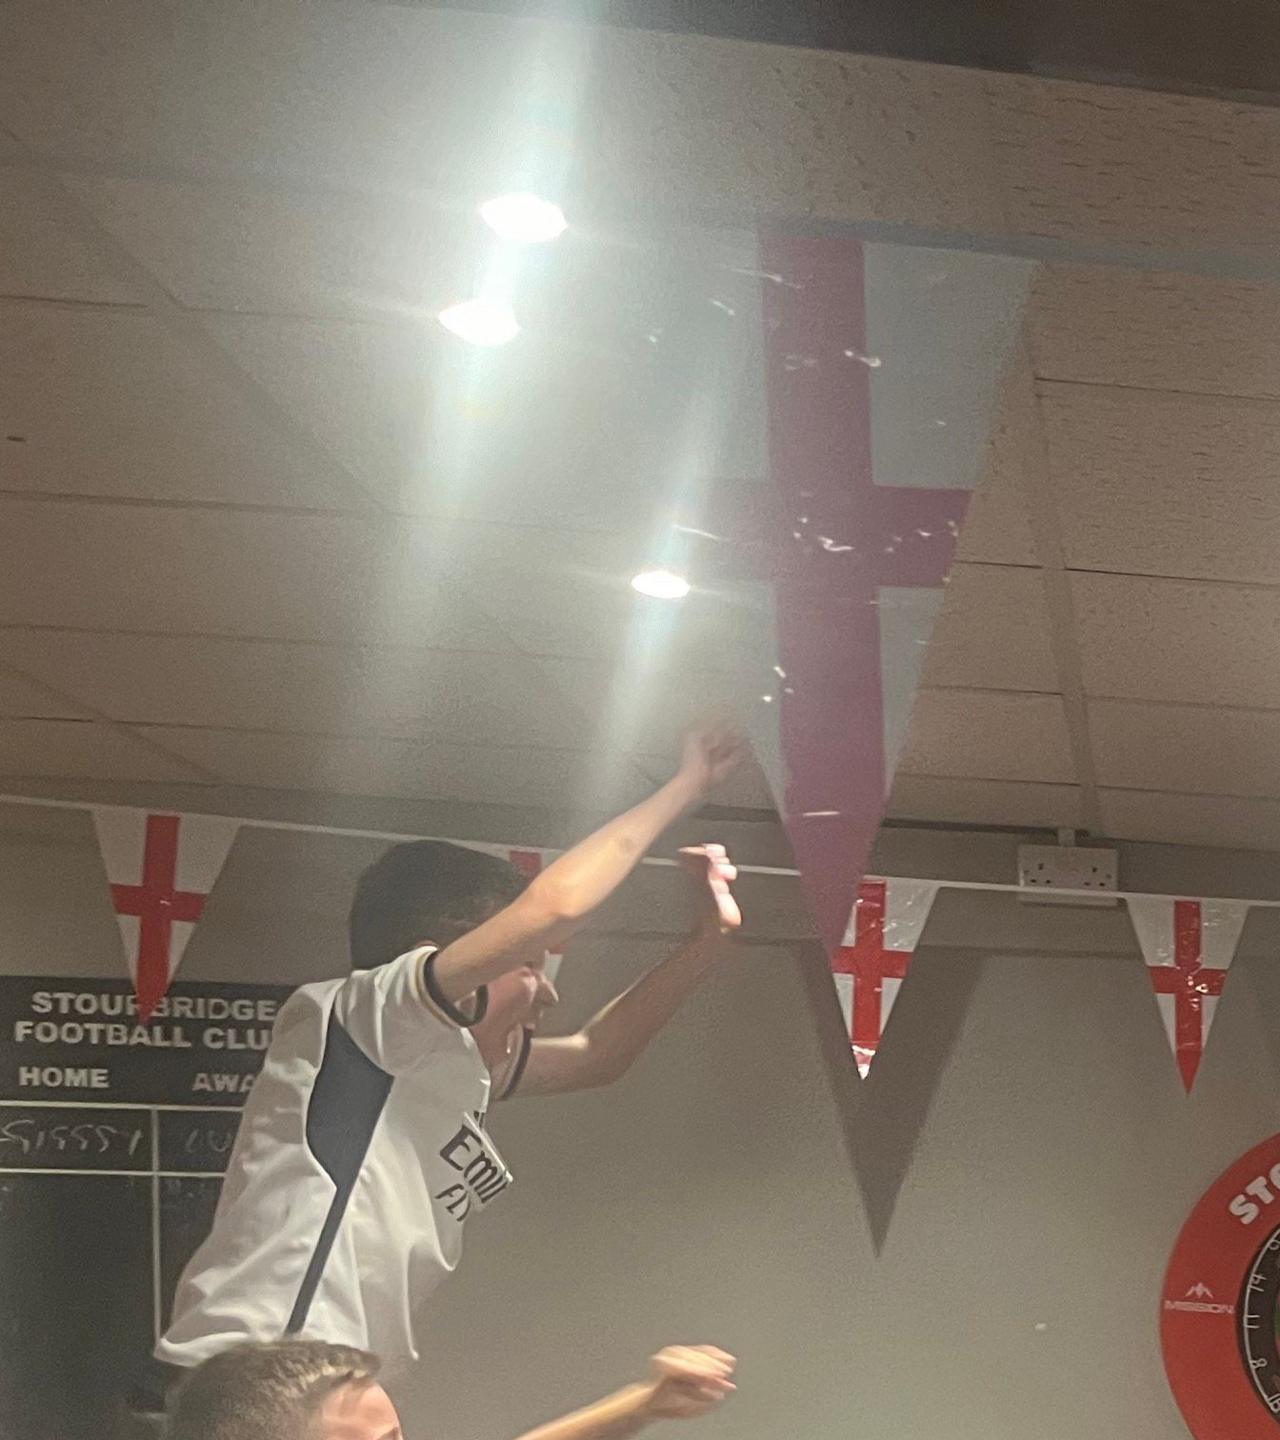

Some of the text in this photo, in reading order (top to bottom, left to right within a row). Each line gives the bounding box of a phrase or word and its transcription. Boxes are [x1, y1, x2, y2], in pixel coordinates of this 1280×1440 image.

[15, 1021, 271, 1050] FOOTBALL CLU
[19, 1066, 256, 1093] HOME AWA
